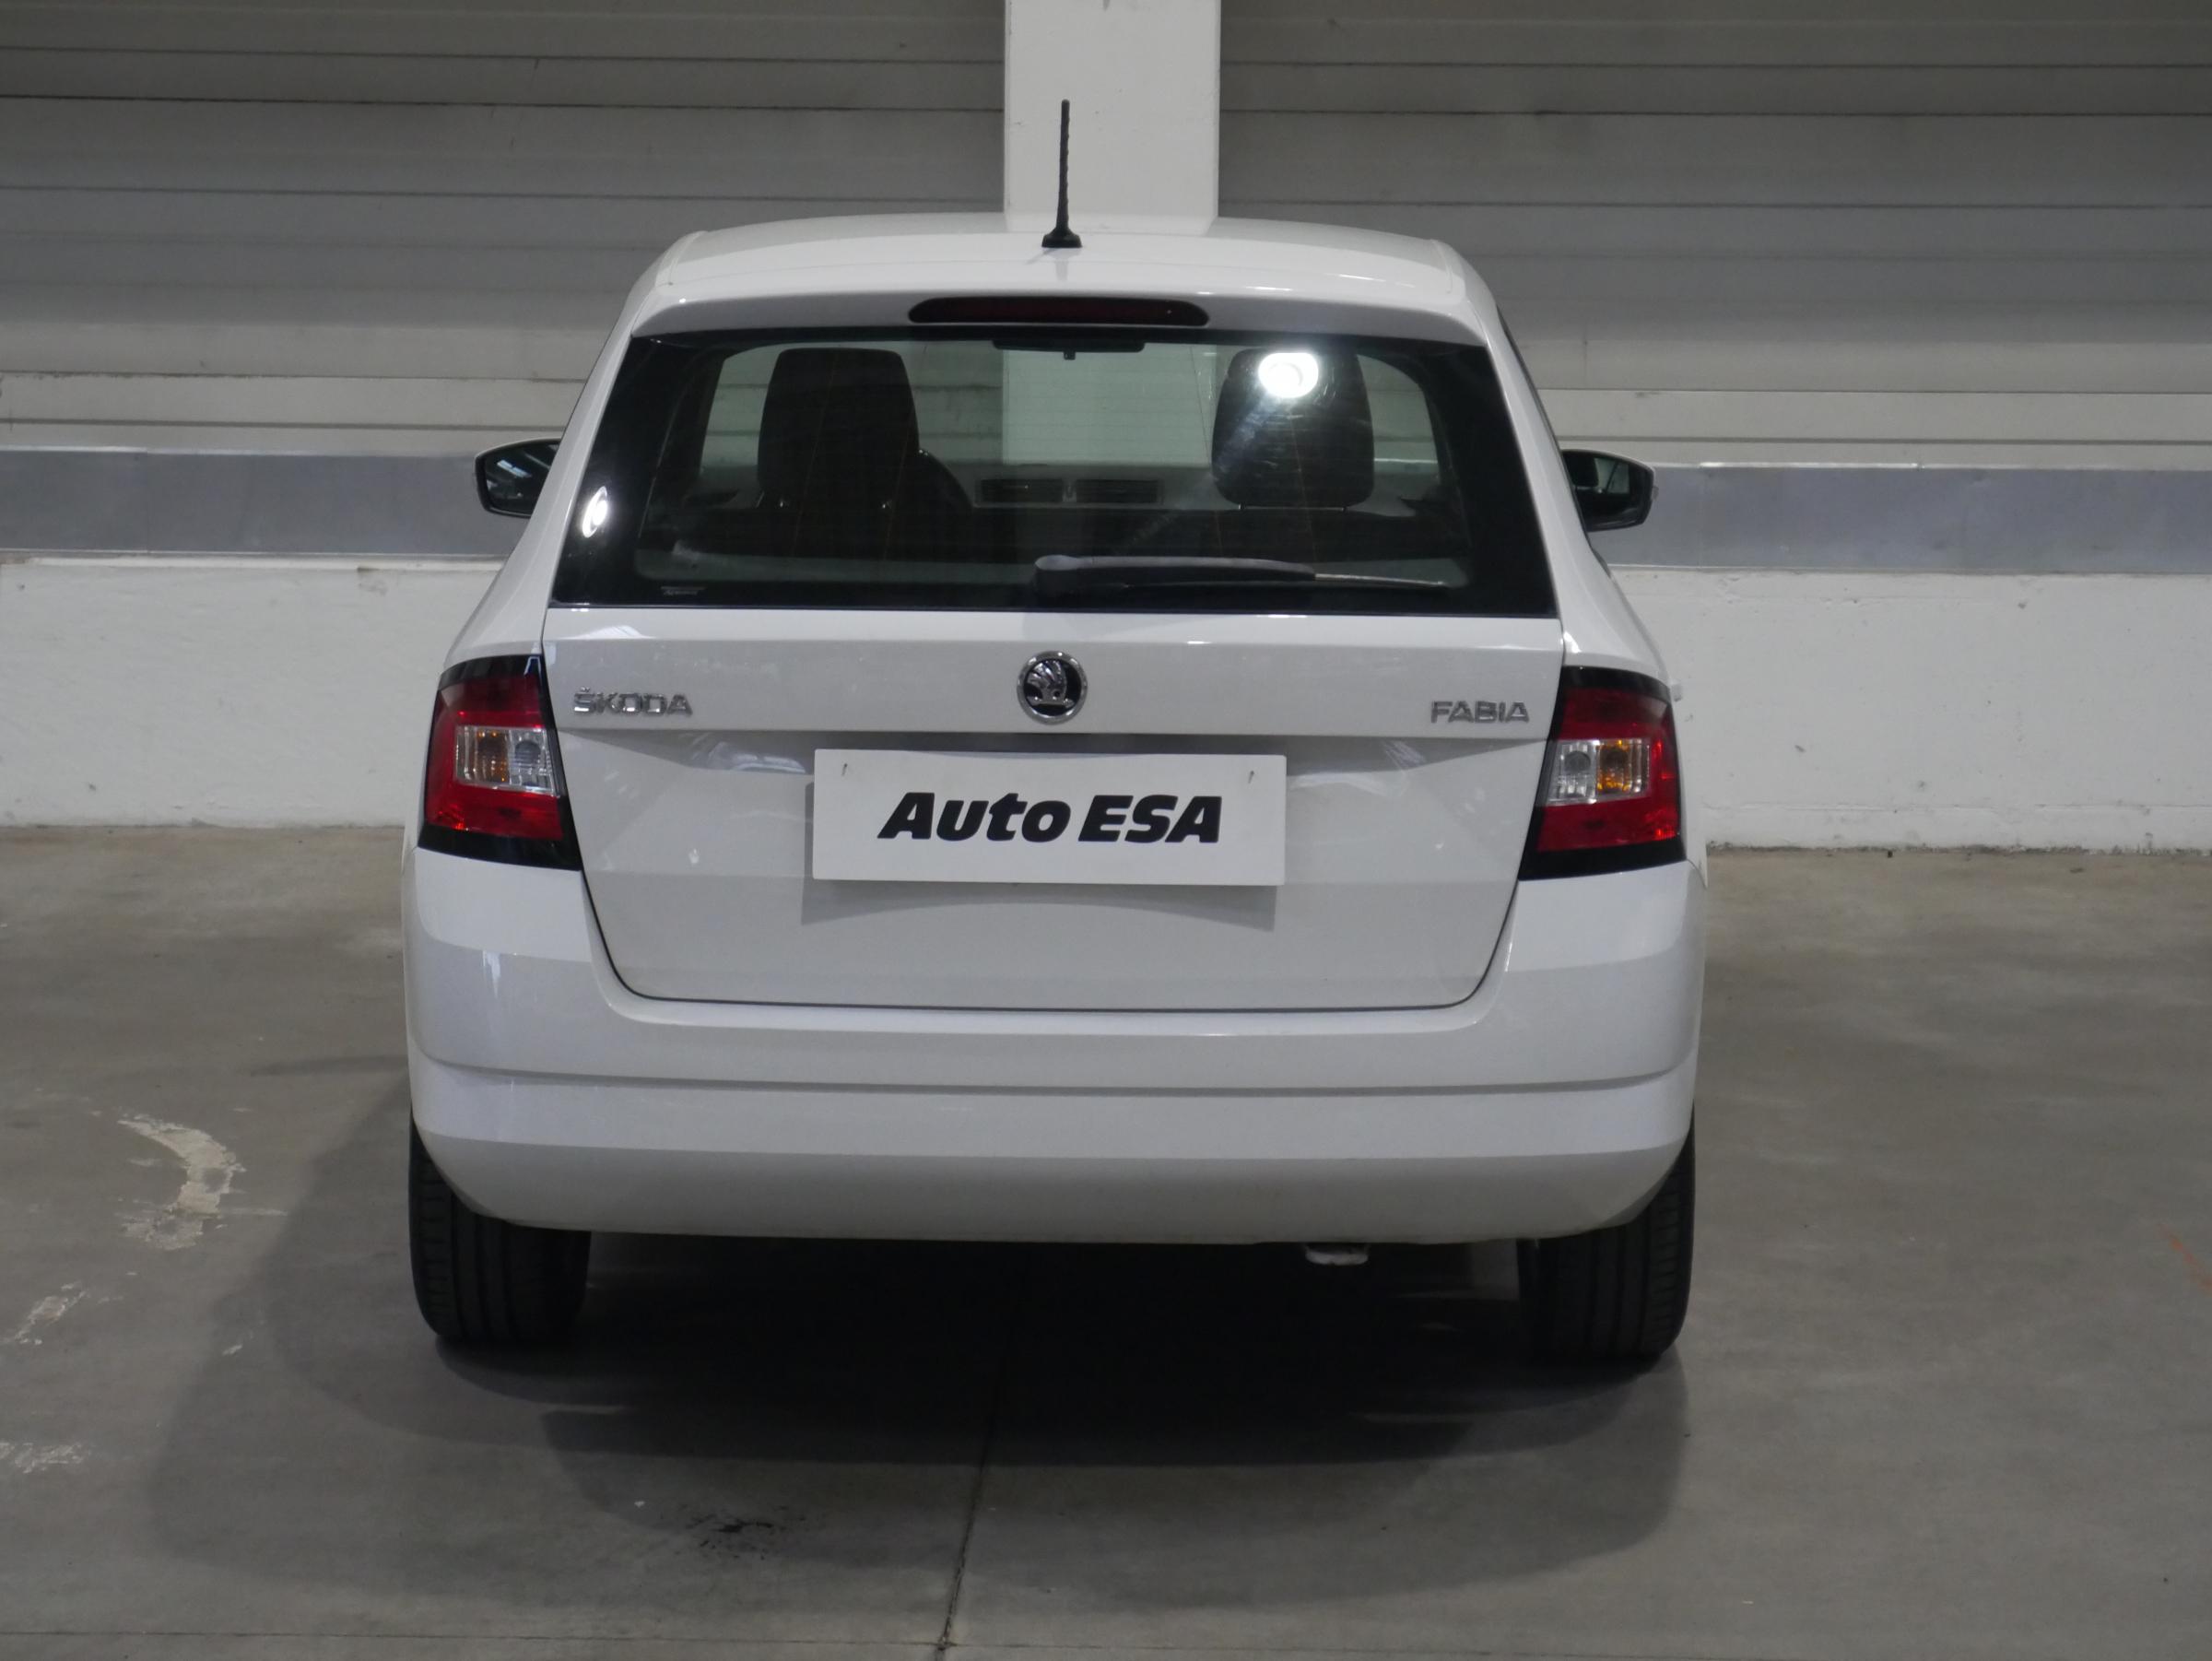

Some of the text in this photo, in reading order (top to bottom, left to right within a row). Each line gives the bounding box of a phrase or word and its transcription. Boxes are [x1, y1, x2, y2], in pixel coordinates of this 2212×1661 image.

[573, 687, 693, 715] ŠKODA
[1430, 701, 1530, 724] FABIA
[877, 792, 1222, 843] Auto ESA
